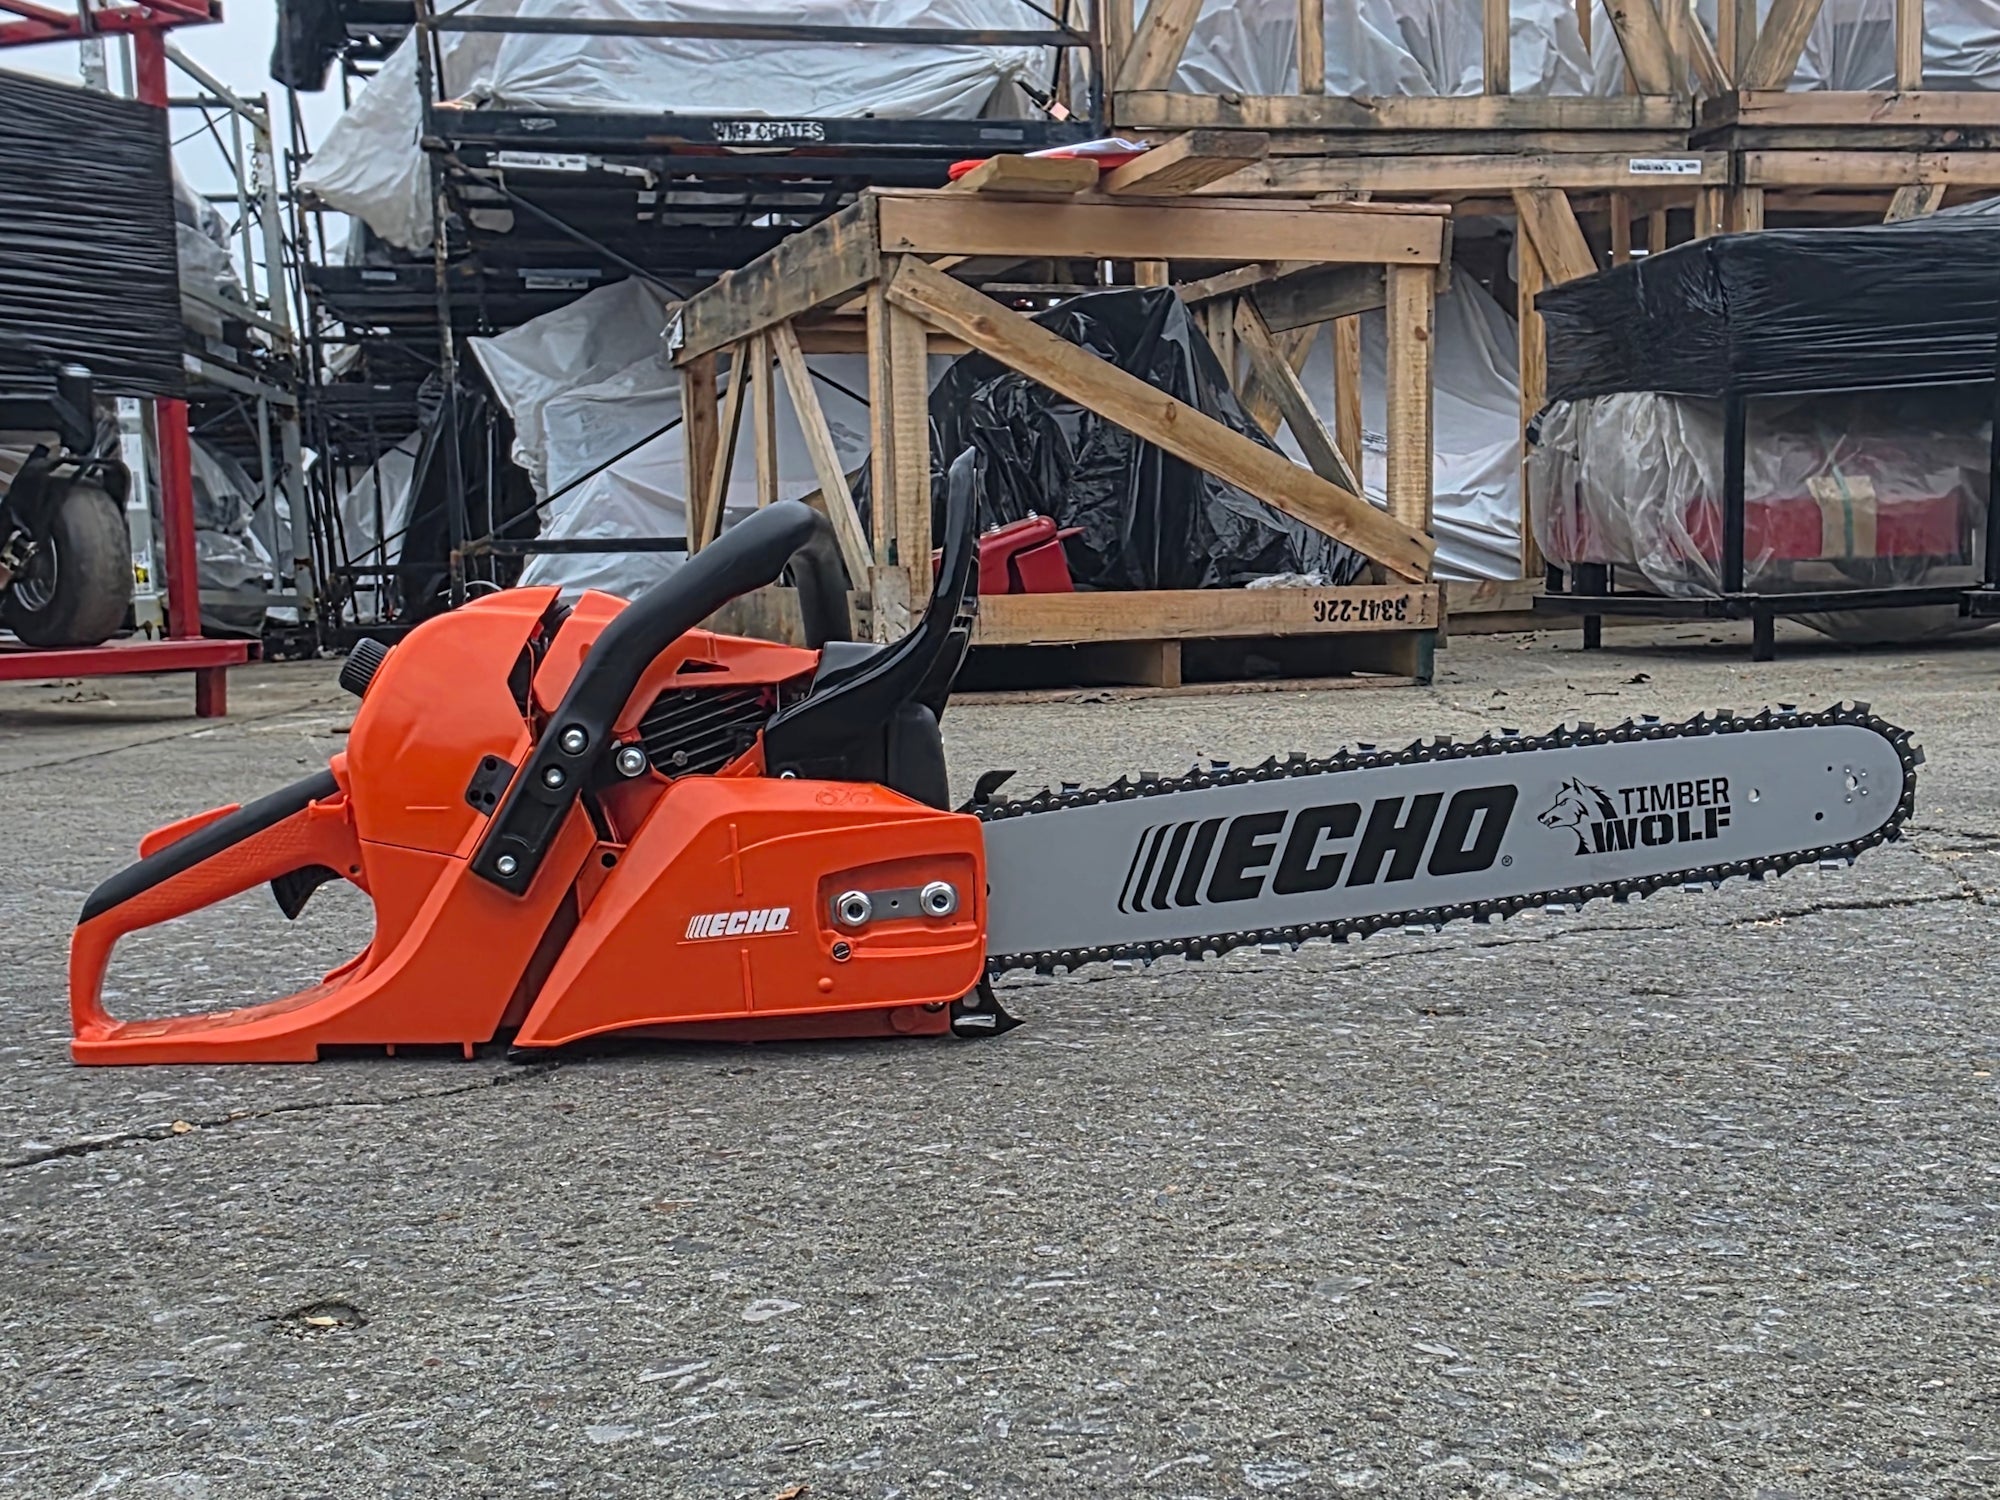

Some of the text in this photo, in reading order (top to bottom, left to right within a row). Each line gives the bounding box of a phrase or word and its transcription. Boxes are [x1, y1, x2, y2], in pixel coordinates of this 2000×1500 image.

[756, 121, 825, 140] CRATES
[1618, 777, 1729, 815] TIMBER
[1206, 784, 1518, 903] ECHO
[1591, 805, 1731, 853] WOLF
[707, 908, 790, 936] ECHO
